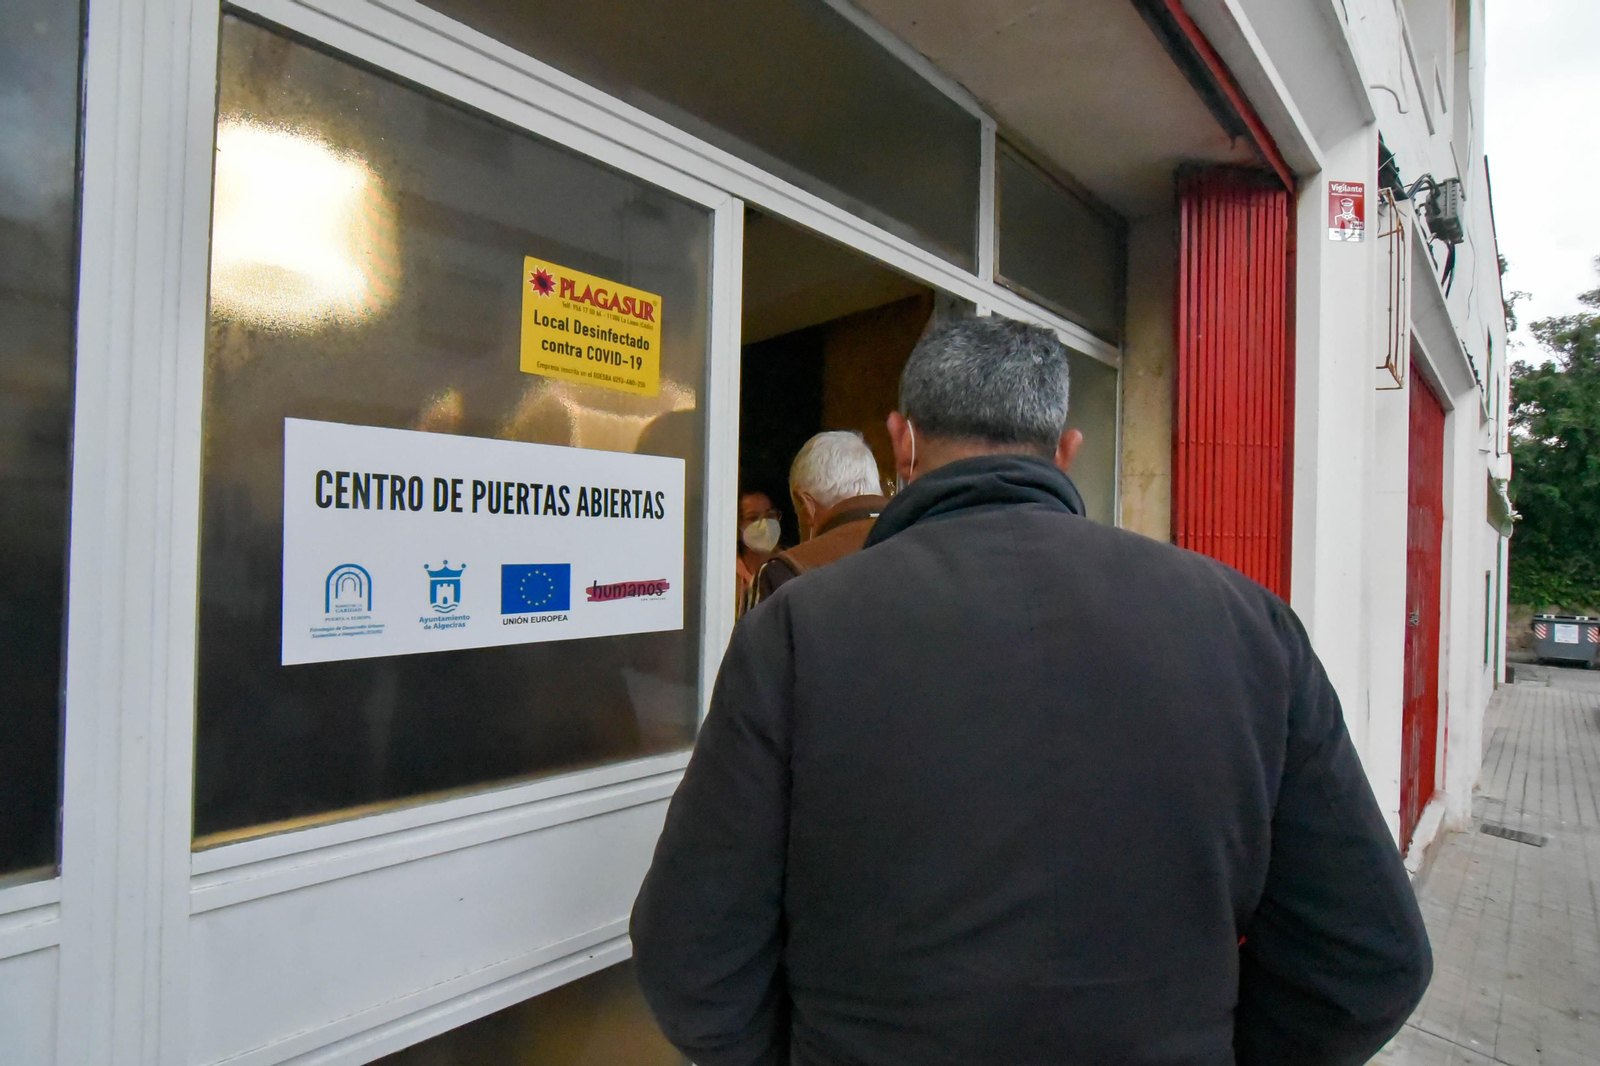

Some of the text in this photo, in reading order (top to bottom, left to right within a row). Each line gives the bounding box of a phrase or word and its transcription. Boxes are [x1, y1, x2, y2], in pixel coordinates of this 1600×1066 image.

[1331, 183, 1363, 193] Vigilante
[559, 276, 655, 323] PLAGASUR
[534, 309, 650, 351] Local Desinfectado
[541, 339, 643, 371] contra COVID-19
[537, 361, 559, 372] Empresa
[315, 469, 665, 520] CENTRO DE PUERTAS ABIERTAS
[593, 580, 666, 599] humanos
[419, 614, 471, 624] Ayuntamiento
[433, 622, 466, 631] Algeciras
[502, 614, 568, 626] UNIÓN EUROPEA
